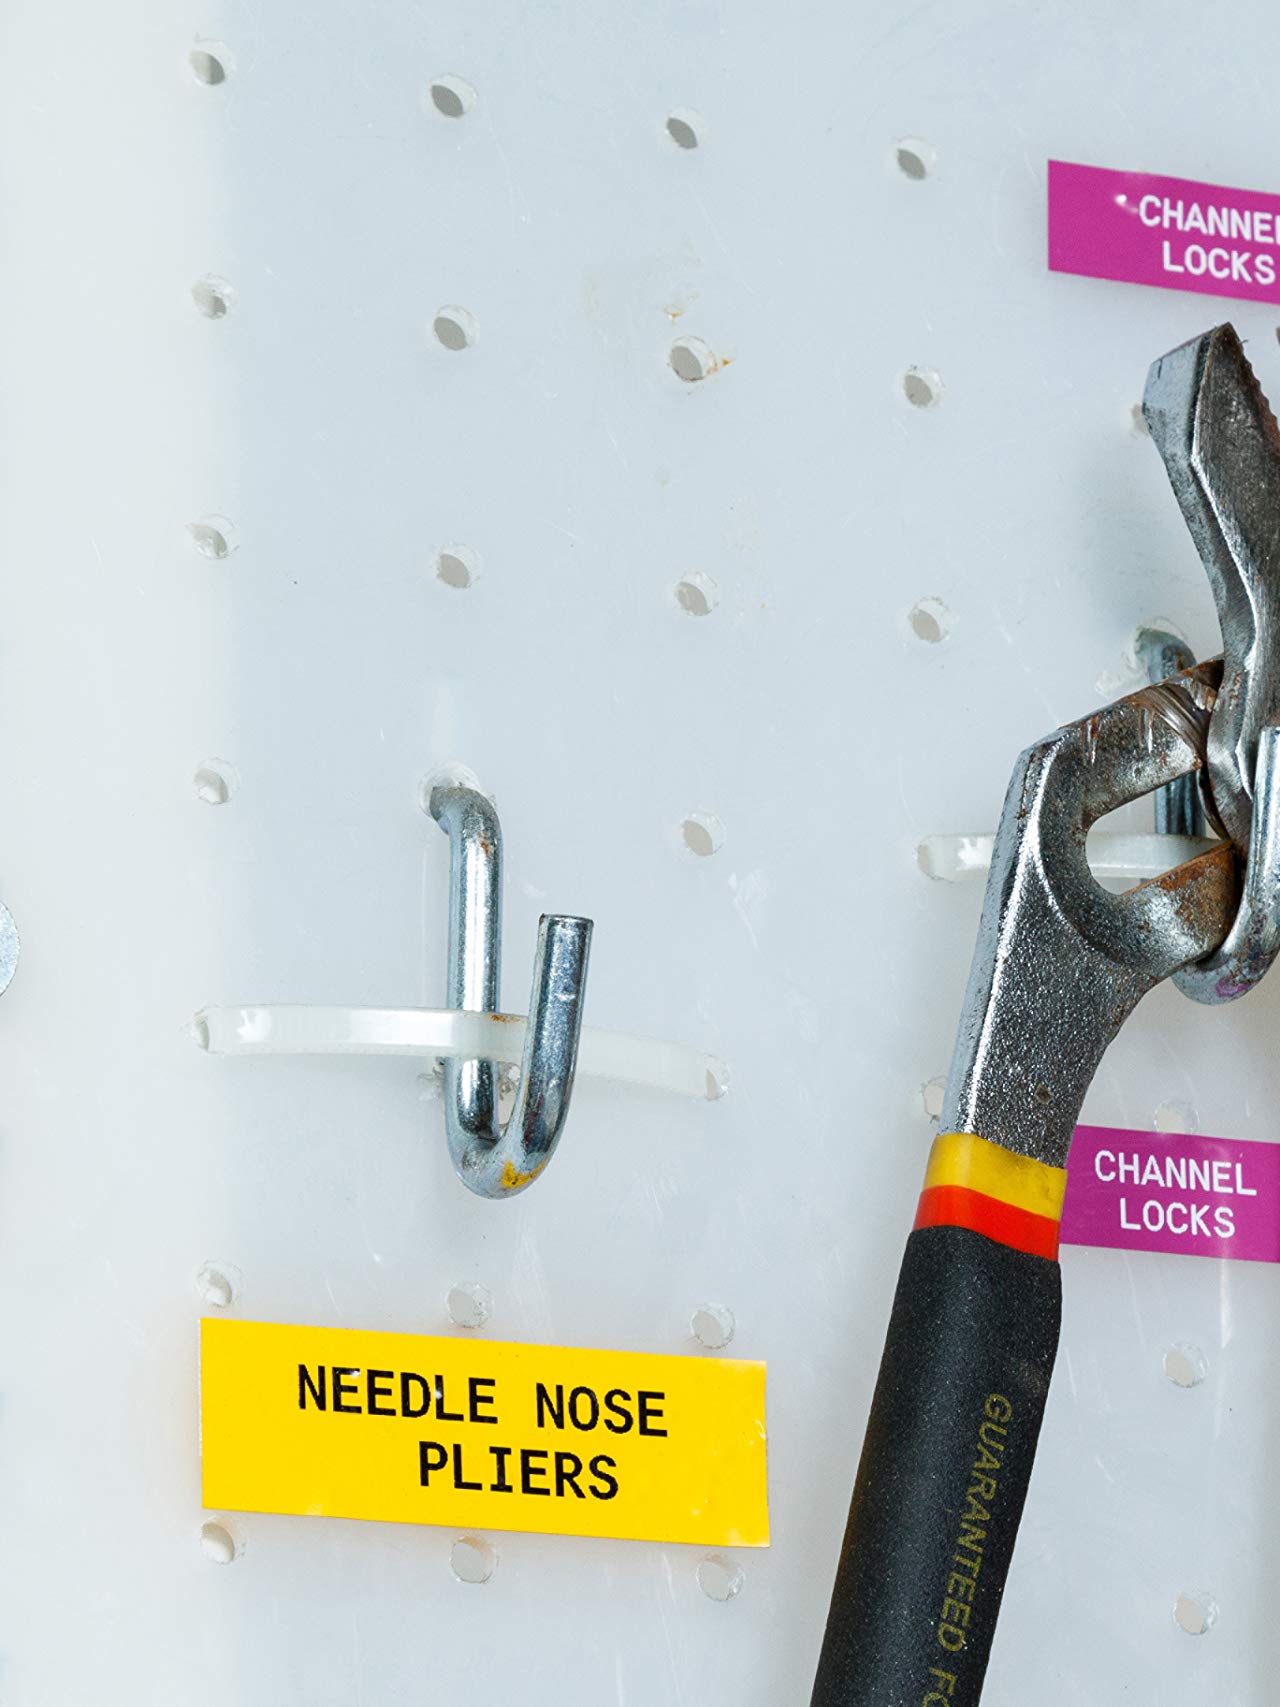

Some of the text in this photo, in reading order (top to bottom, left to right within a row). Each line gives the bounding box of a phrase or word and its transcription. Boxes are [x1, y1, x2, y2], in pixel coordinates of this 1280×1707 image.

[1162, 240, 1276, 285] LOCKS
[1094, 1150, 1257, 1196] CHANNEL
[1119, 1197, 1235, 1239] LOCKS
[297, 1363, 669, 1438] NEEDLE NOSE
[418, 1440, 620, 1500] PLIERS
[937, 1392, 1014, 1652] GUARANTEED
